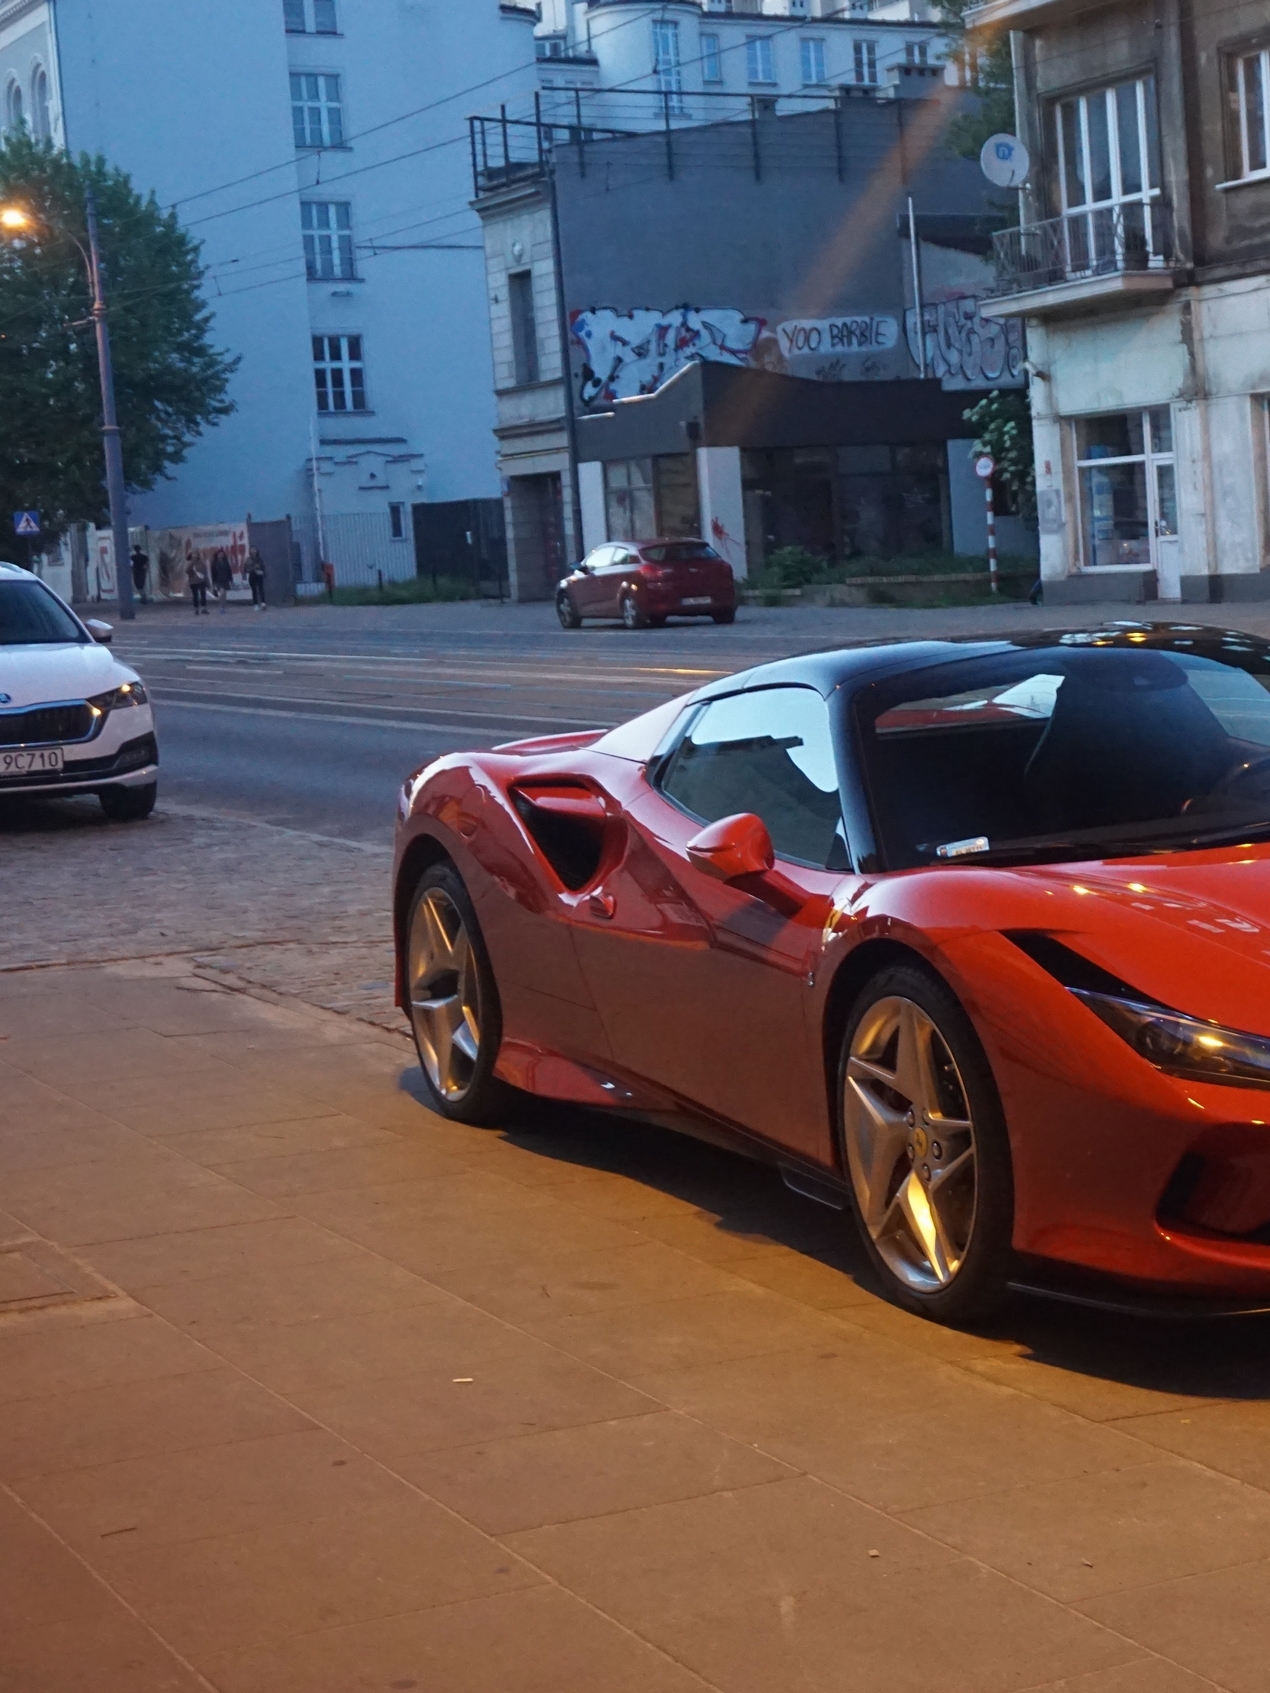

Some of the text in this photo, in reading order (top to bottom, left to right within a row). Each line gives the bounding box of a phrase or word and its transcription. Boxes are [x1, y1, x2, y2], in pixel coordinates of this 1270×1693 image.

[782, 316, 888, 352] YOO BARBIE
[3, 751, 59, 770] 9C710
